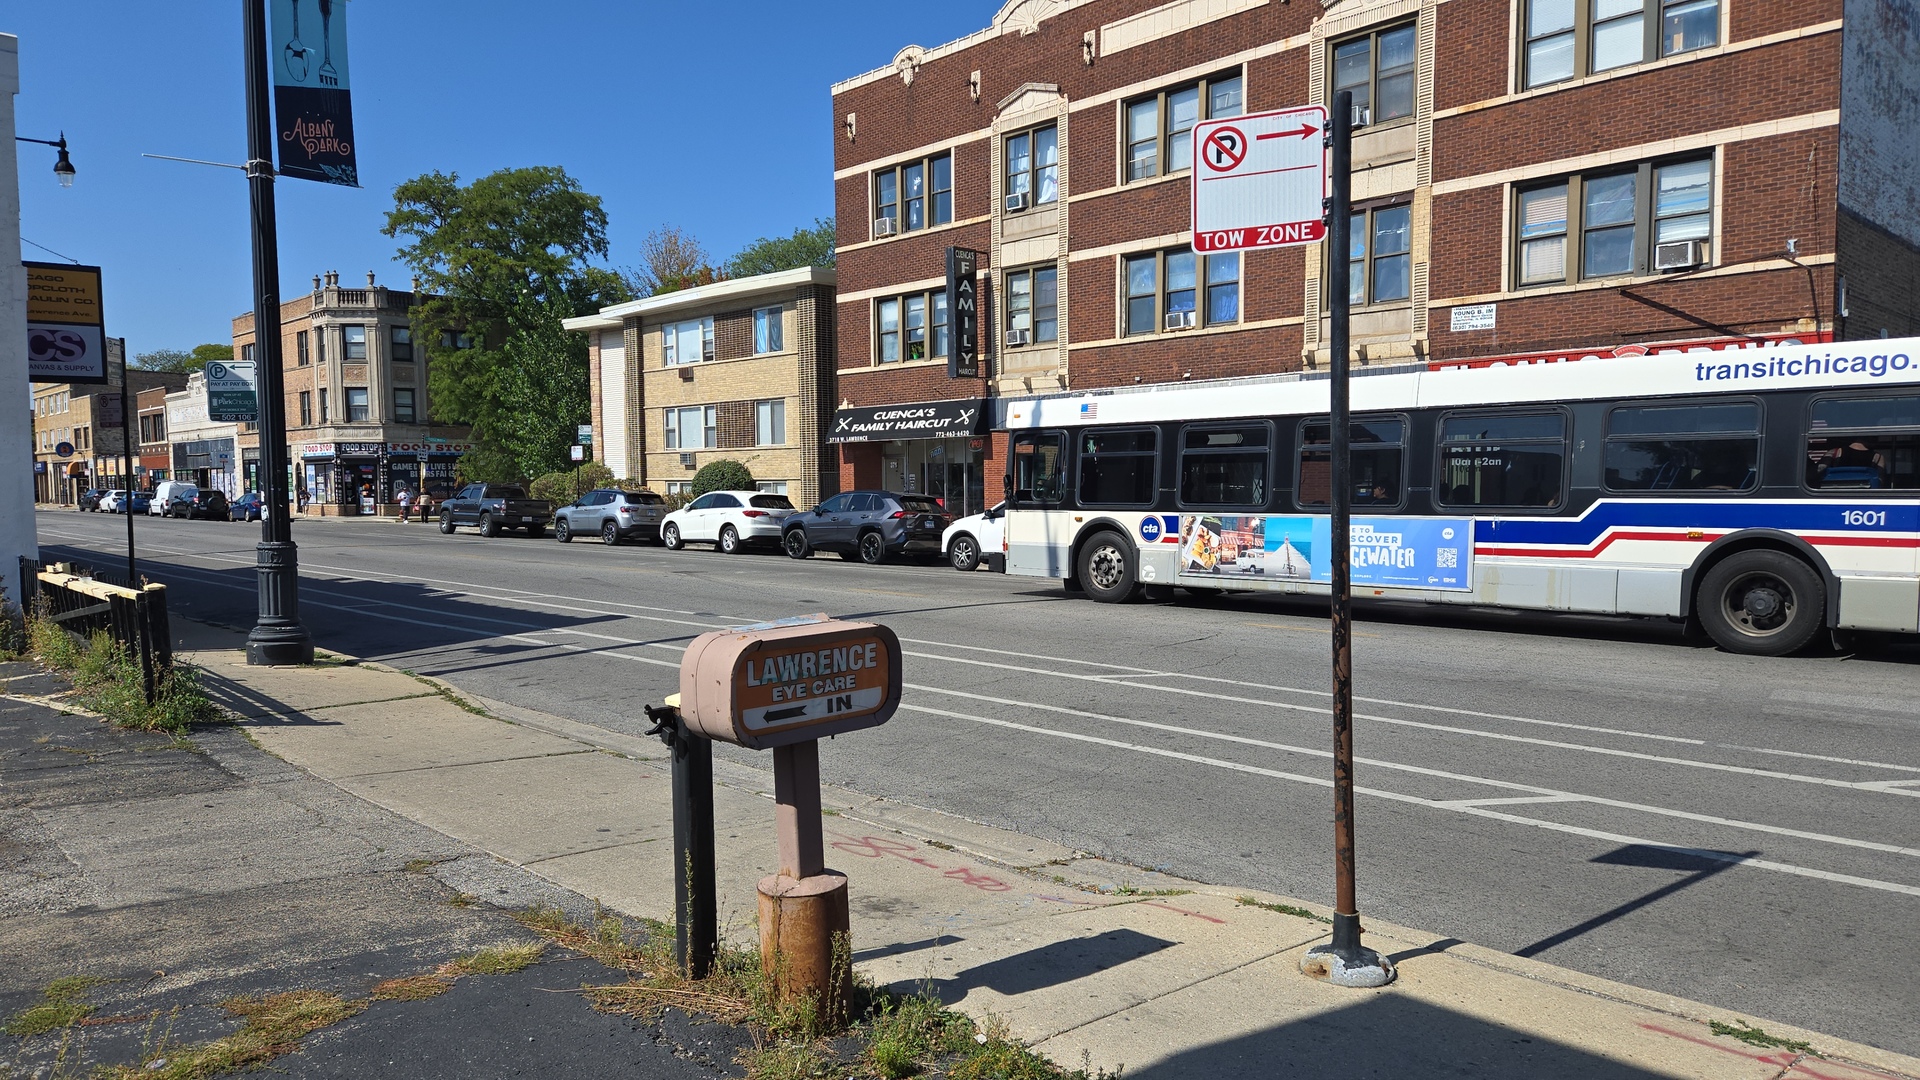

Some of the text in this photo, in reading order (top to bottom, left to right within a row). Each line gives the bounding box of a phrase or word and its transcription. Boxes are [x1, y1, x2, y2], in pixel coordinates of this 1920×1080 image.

[283, 117, 335, 140] ALBANY
[304, 138, 350, 160] PARK
[1202, 222, 1314, 249] TOW ZONE
[958, 261, 974, 365] FAMILY
[850, 418, 952, 432] FAMILY HAIRCUT
[873, 408, 936, 421] CUENCA'S
[1841, 510, 1886, 526] 1601
[1351, 535, 1398, 544] SCOVER
[1351, 546, 1416, 569] GEWATER
[746, 642, 877, 688] LAWRENCE
[772, 675, 856, 702] EYE CARE
[827, 694, 853, 714] IN
